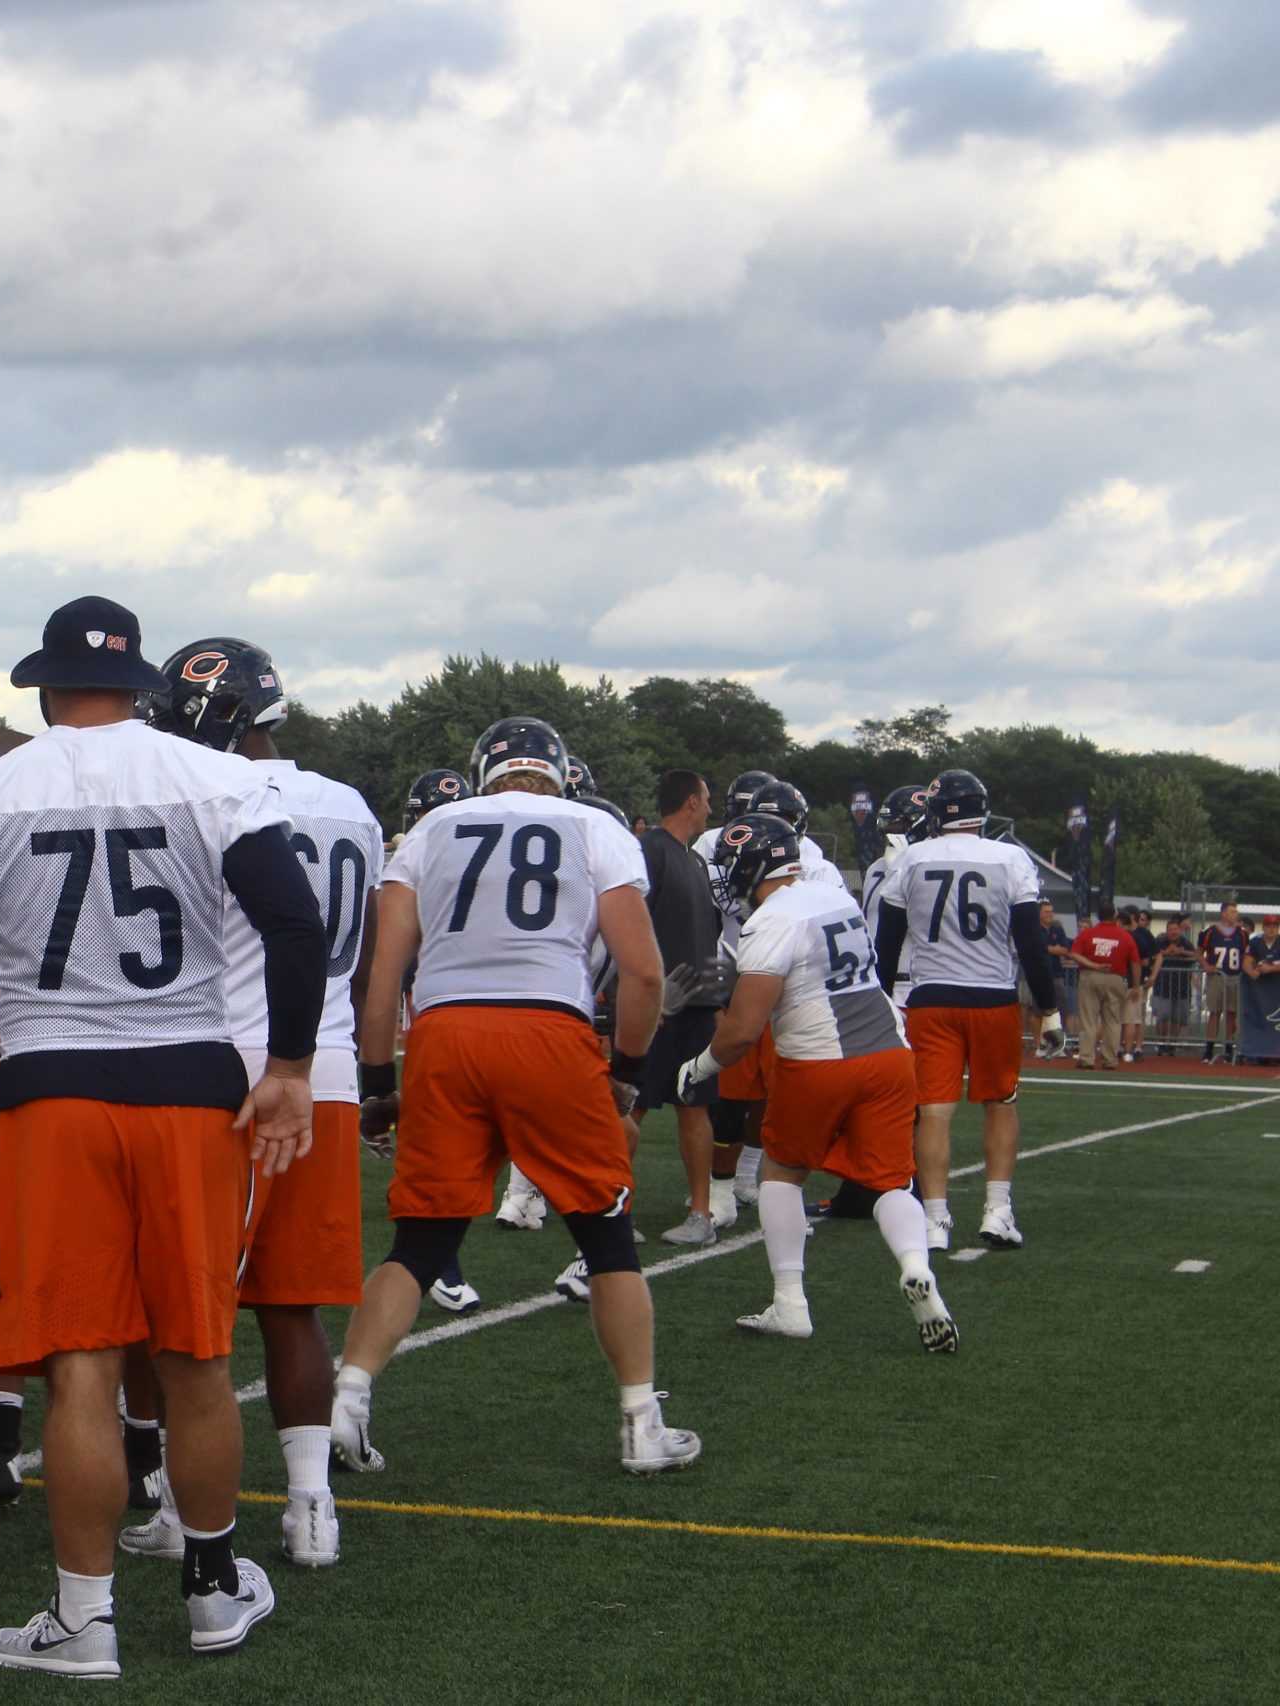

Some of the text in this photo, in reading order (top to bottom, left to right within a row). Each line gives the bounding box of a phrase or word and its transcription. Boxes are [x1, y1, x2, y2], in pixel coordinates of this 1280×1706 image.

[30, 826, 183, 991] 75
[448, 823, 562, 932] 78
[924, 870, 987, 944] 76
[1214, 946, 1241, 971] 78
